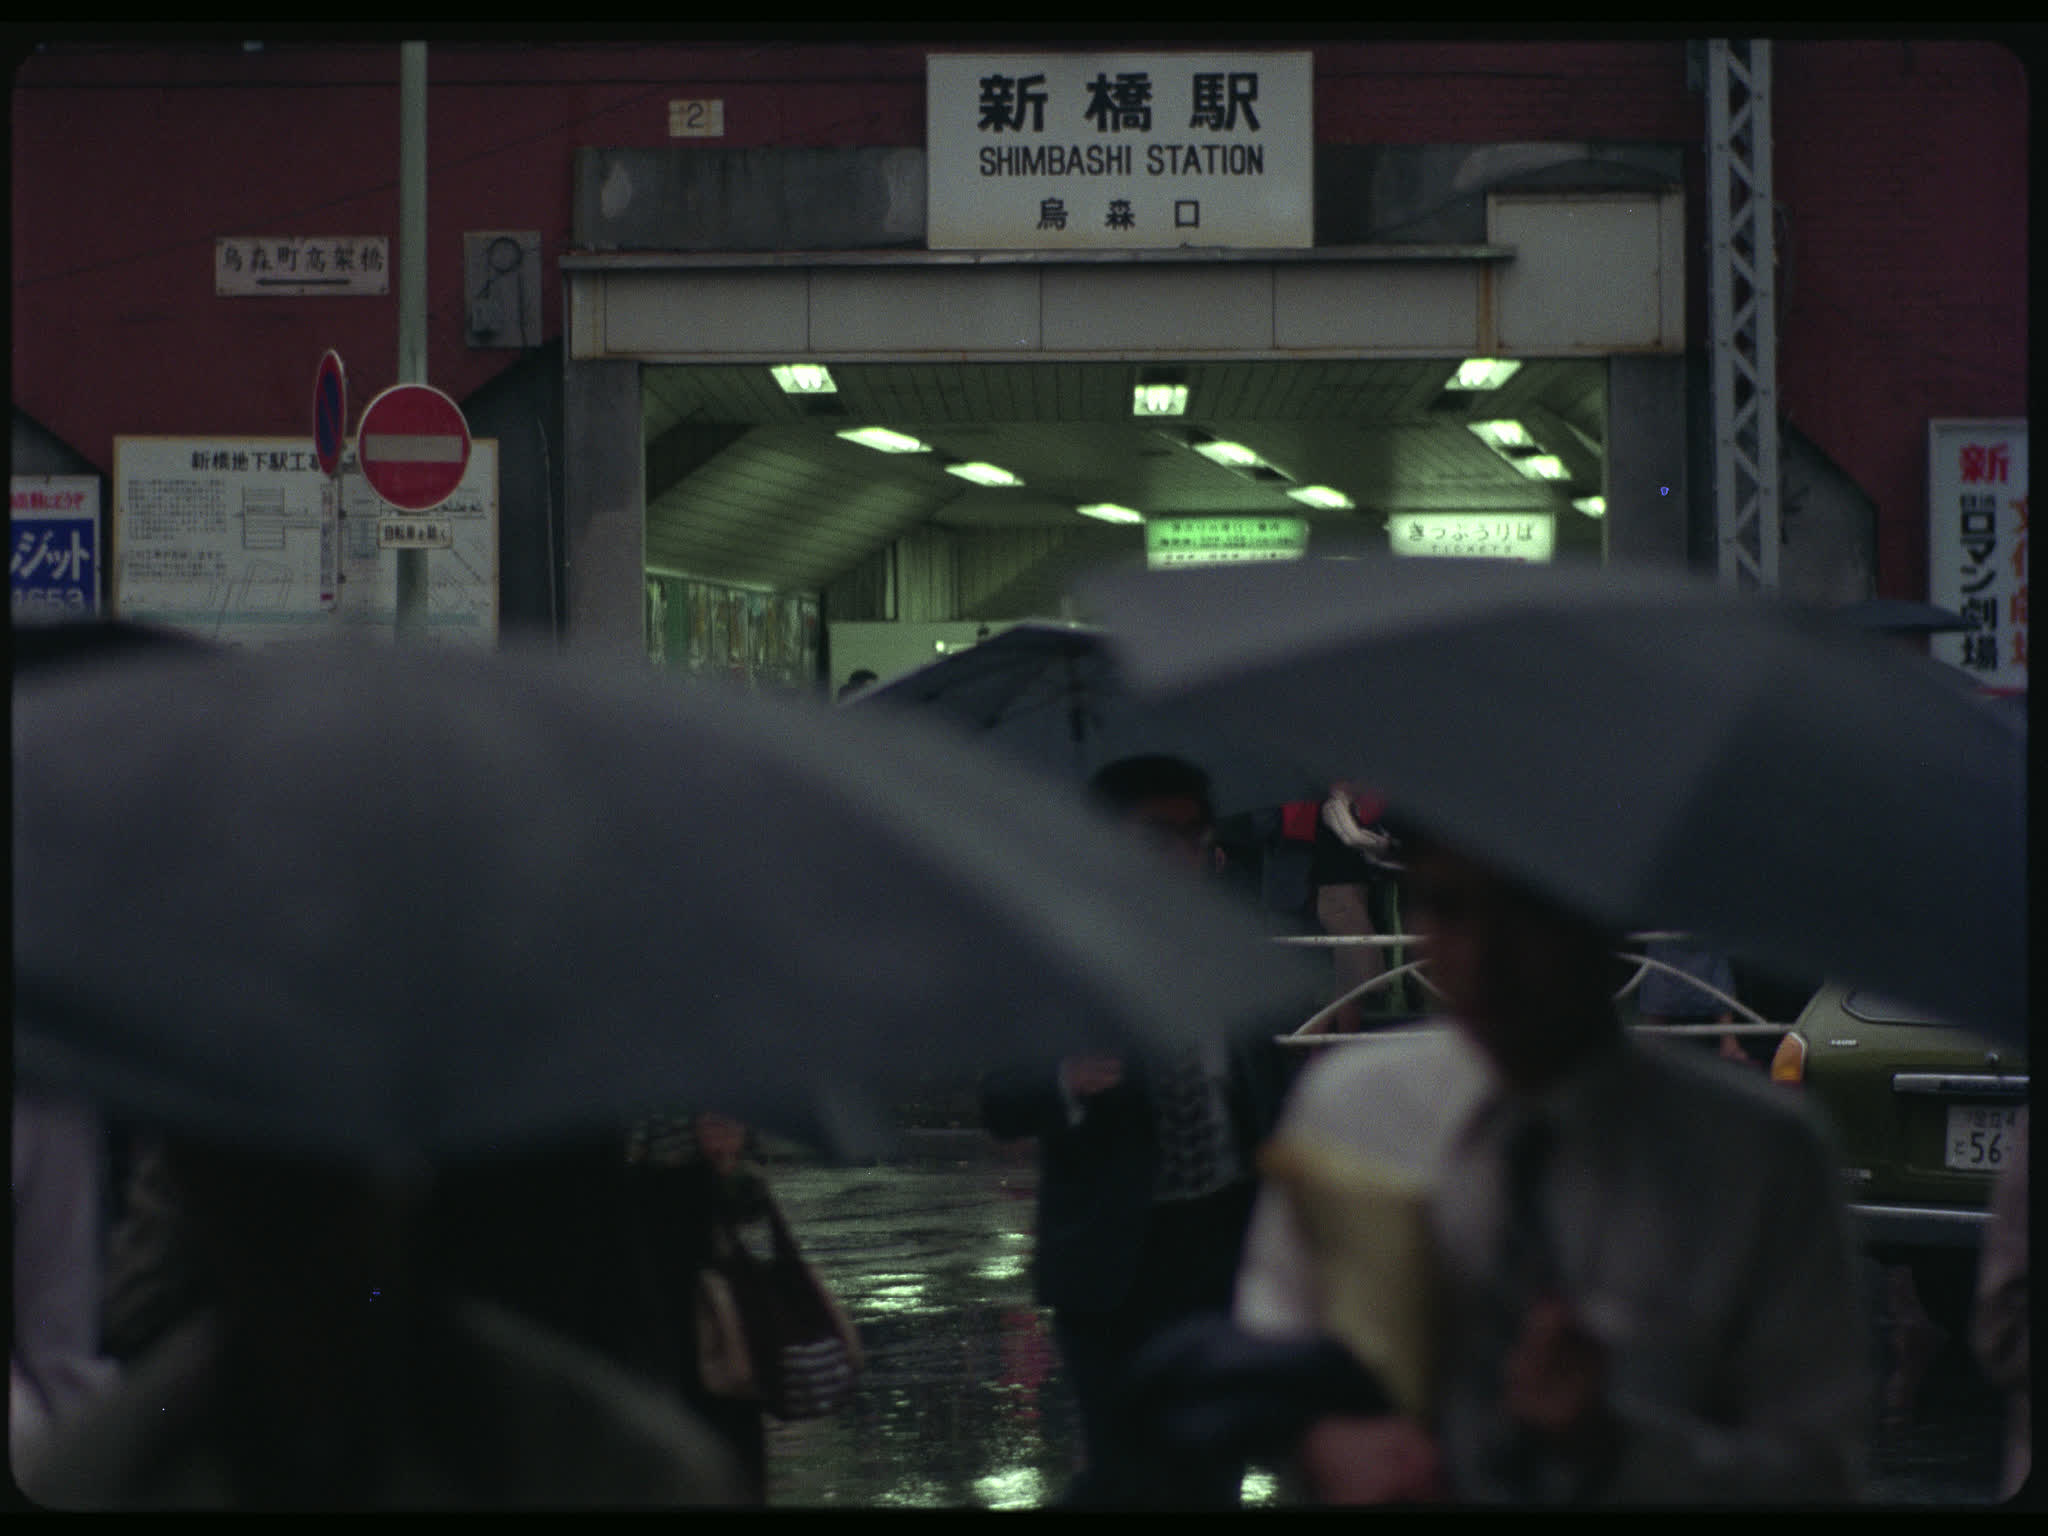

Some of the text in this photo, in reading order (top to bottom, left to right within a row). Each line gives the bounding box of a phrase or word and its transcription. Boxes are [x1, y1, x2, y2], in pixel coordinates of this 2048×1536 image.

[977, 72, 1260, 133] 新橋駅
[979, 144, 1264, 176] SHIMBASHI STATION
[1036, 197, 1201, 231] 烏森口
[1959, 441, 2010, 484] 新
[10, 529, 90, 582] ジット
